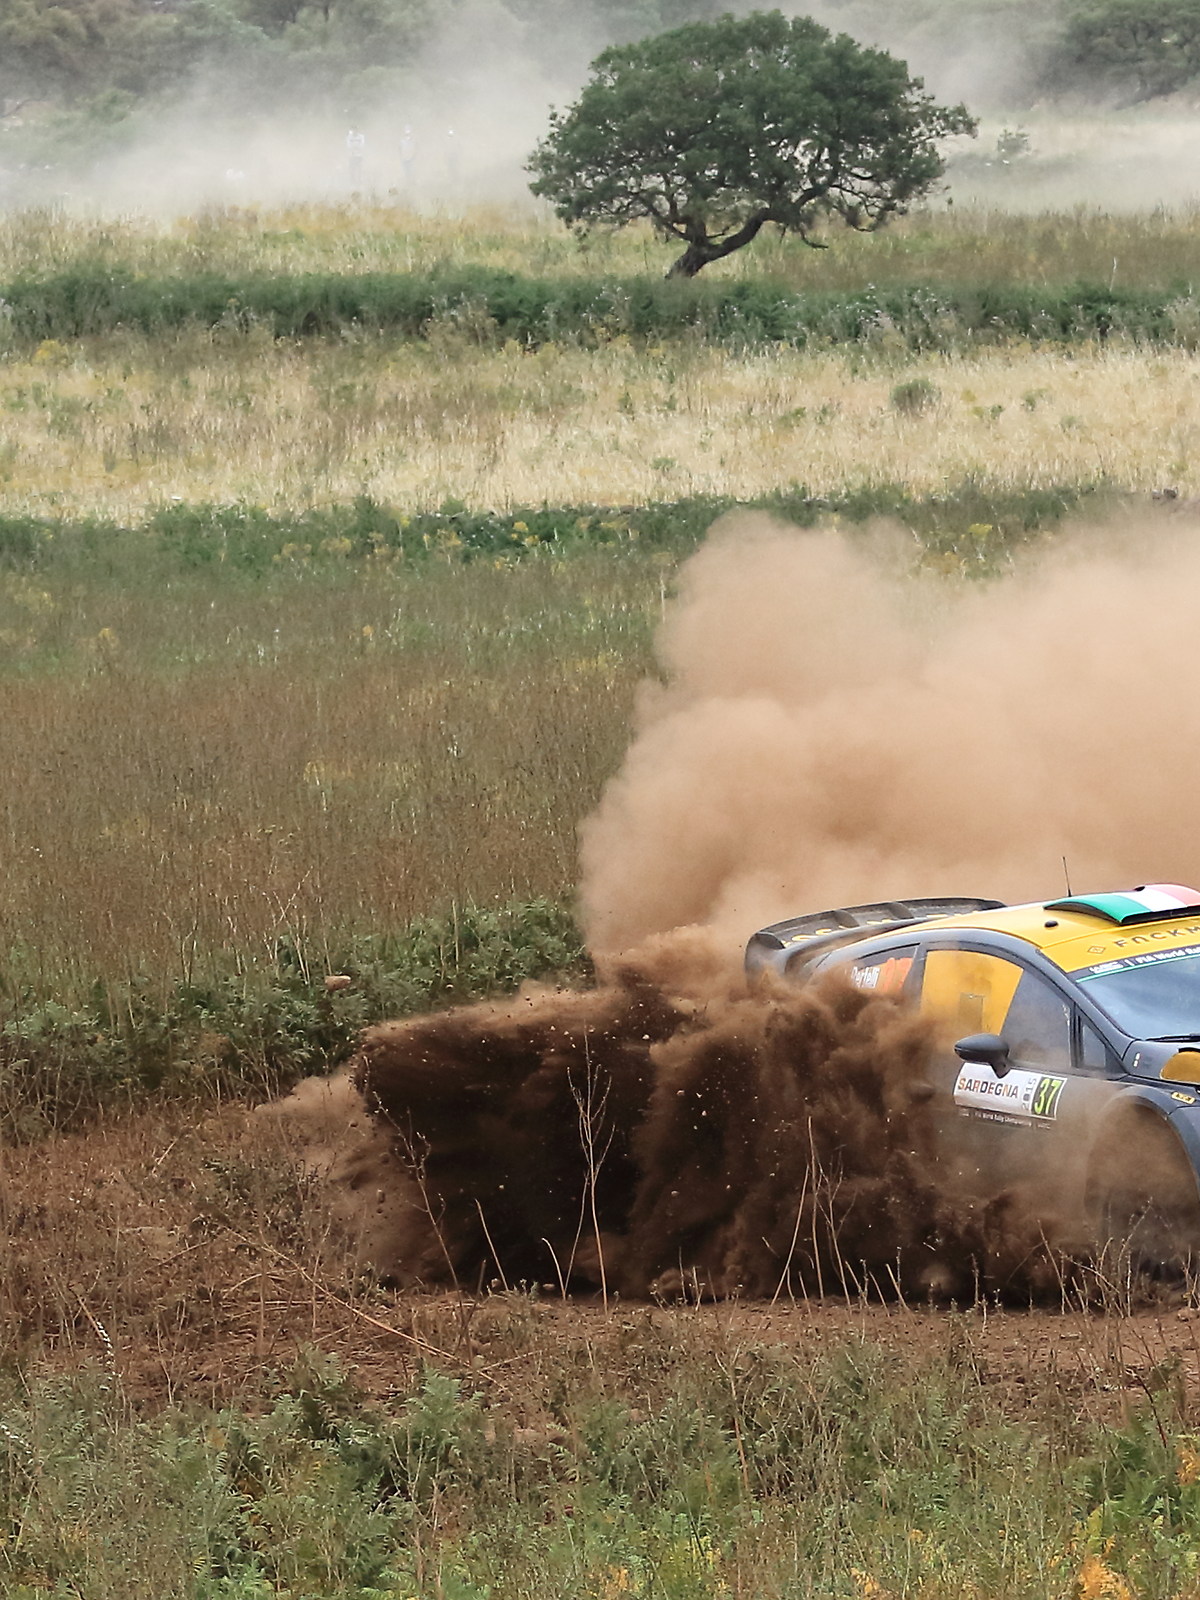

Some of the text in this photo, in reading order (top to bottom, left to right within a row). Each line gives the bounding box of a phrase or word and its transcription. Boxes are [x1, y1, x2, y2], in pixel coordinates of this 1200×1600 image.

[1154, 948, 1186, 961] World
[958, 1077, 1019, 1099] SARDEGNA
[1034, 1077, 1063, 1116] 37
